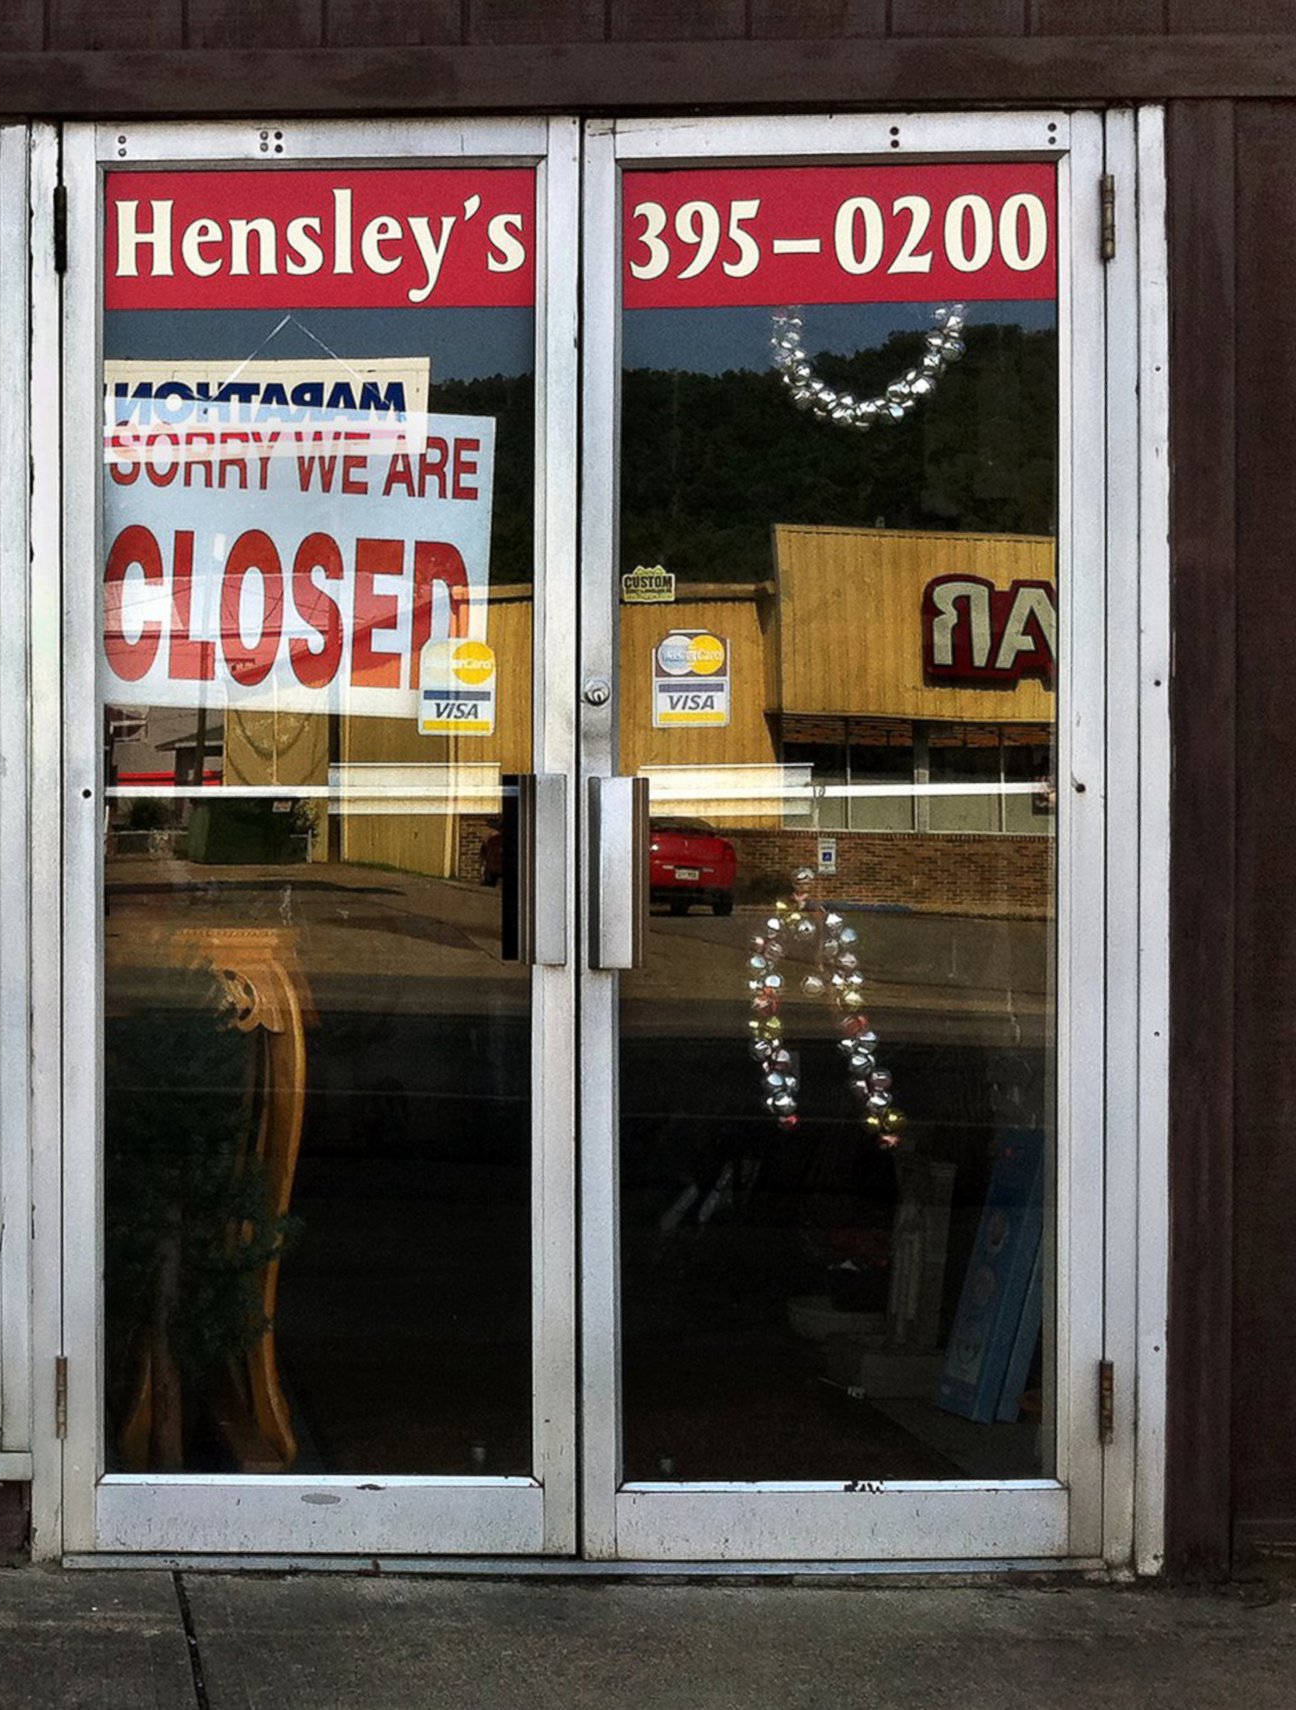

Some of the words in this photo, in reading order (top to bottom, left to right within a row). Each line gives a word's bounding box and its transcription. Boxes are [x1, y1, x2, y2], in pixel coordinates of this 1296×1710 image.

[114, 188, 526, 303] Hensley's
[629, 193, 1048, 280] 395-0200
[109, 420, 281, 490] SORRY
[295, 431, 371, 495] WE
[383, 434, 479, 500] ARE
[103, 524, 470, 691] CLOSED
[624, 575, 673, 591] CUSTOM
[434, 702, 479, 719] VISA
[668, 694, 715, 711] VISA
